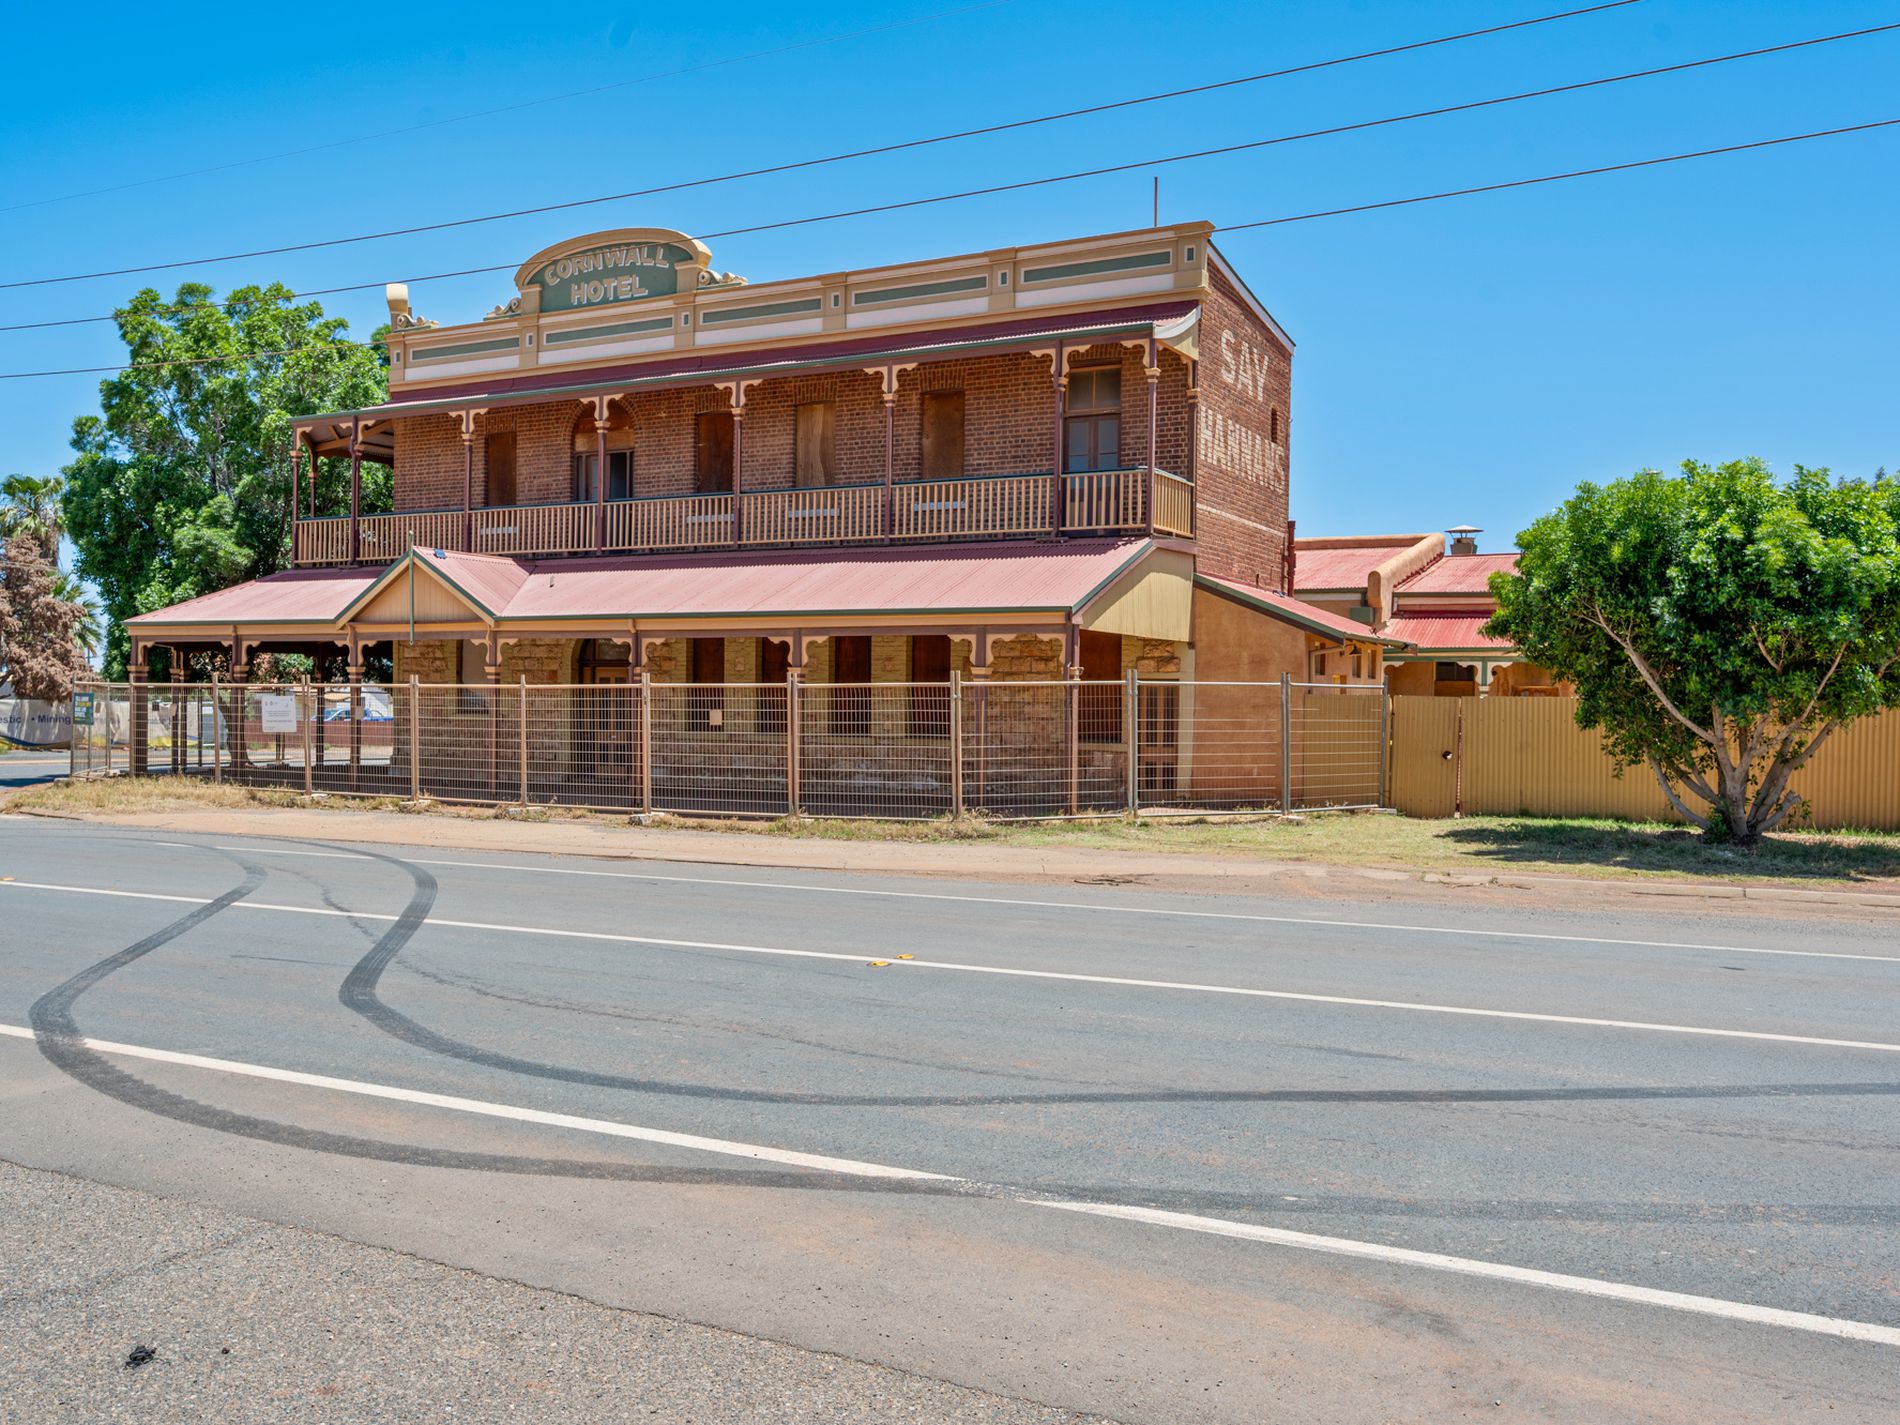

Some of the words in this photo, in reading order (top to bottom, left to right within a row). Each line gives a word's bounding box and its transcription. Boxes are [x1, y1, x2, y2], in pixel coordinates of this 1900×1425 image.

[544, 245, 670, 286] CORNWALL
[571, 275, 649, 305] HOTEL
[1221, 329, 1269, 401] SAY
[1201, 405, 1285, 494] HANNANS
[37, 714, 72, 725] Mining
